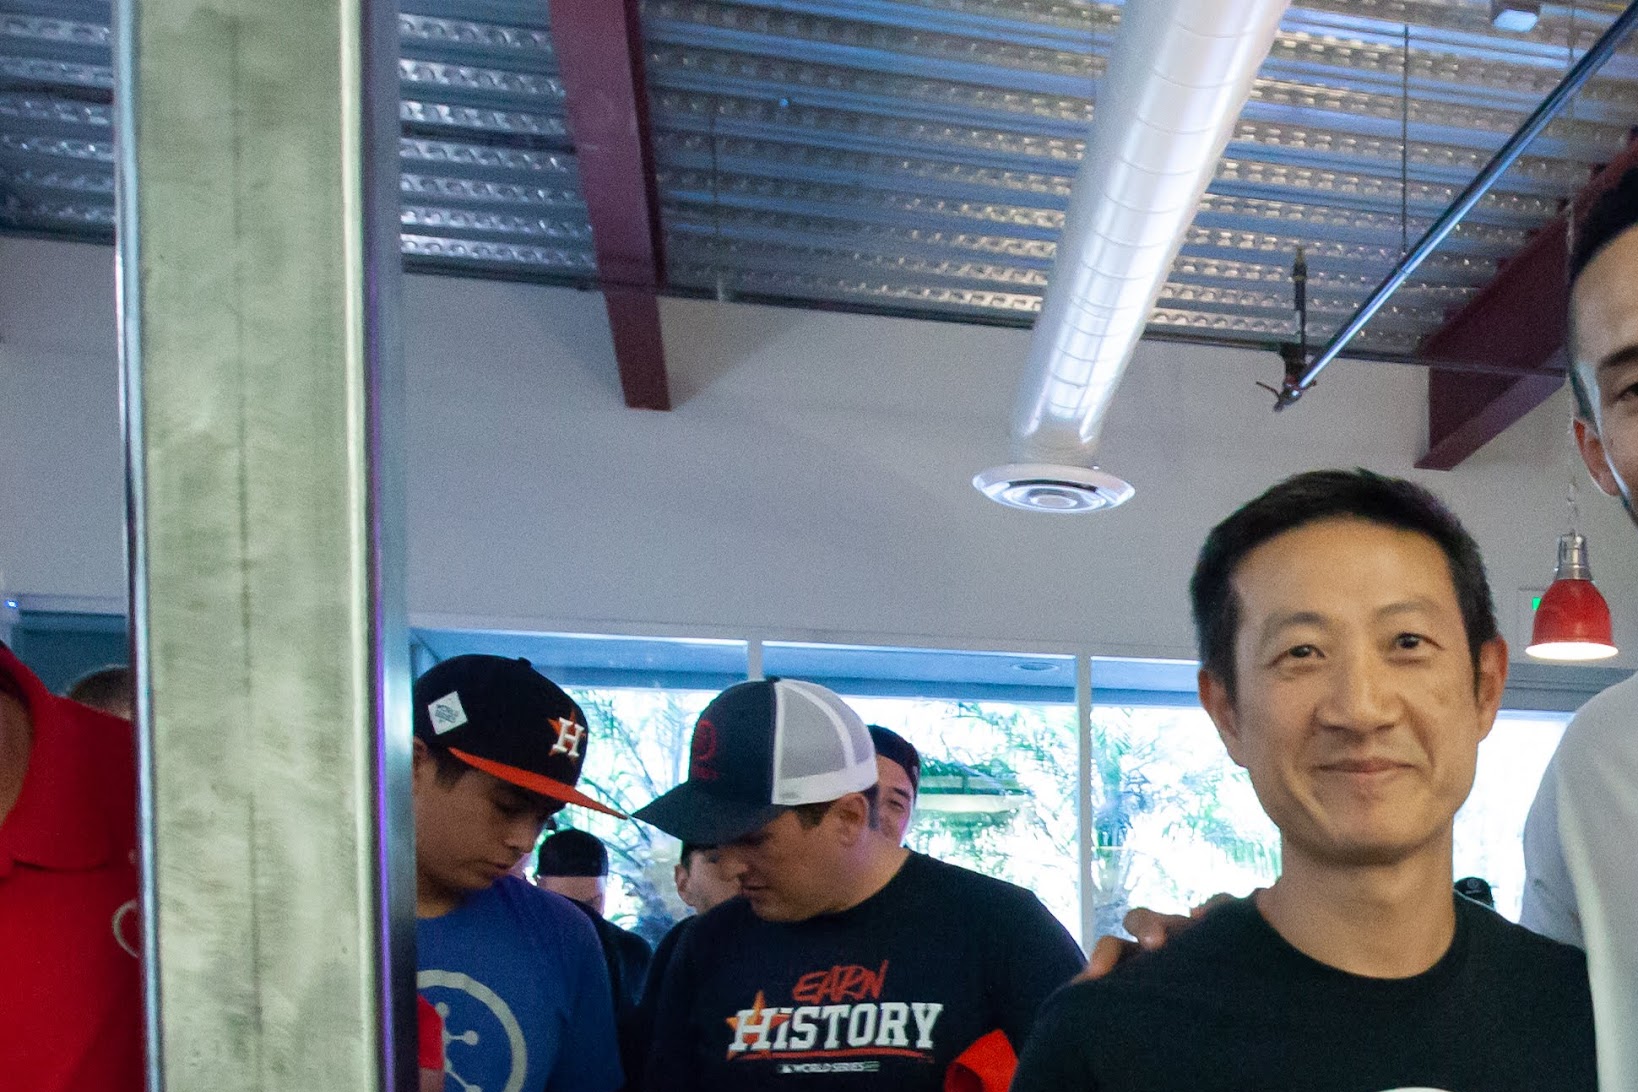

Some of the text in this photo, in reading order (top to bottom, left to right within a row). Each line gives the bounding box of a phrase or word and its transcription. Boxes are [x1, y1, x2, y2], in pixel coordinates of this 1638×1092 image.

[553, 716, 584, 757] H
[792, 960, 889, 1004] EARN
[793, 1063, 831, 1074] WORLD
[830, 1062, 864, 1073] SERIES
